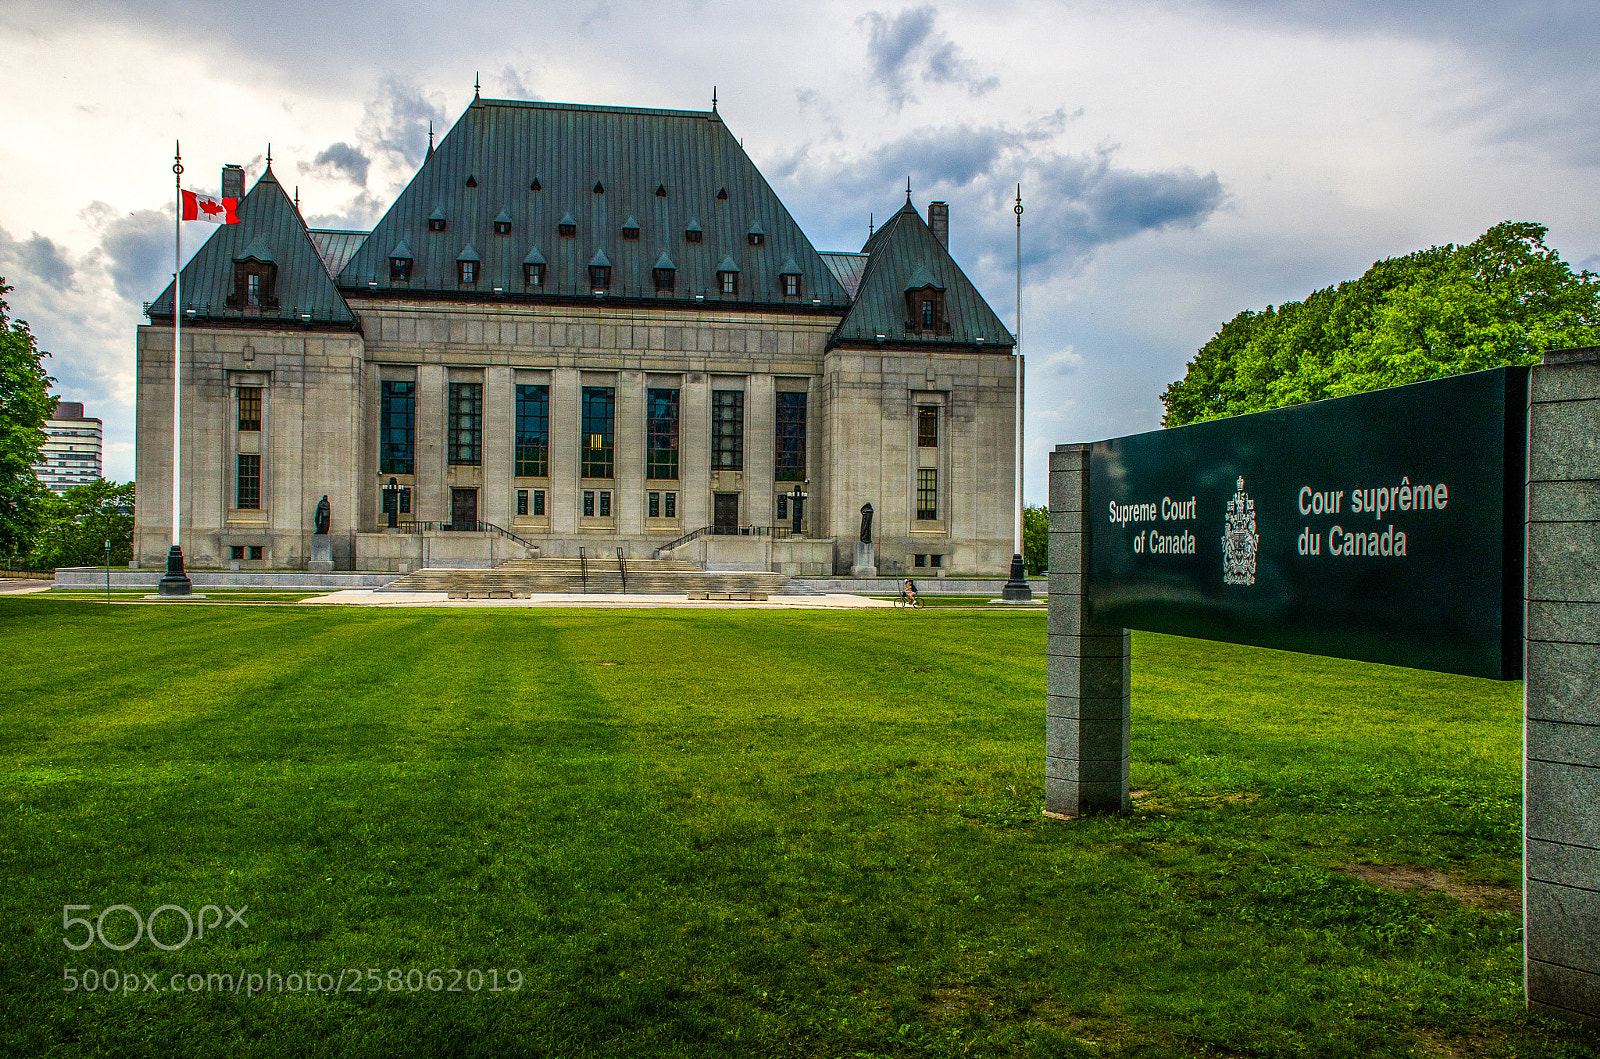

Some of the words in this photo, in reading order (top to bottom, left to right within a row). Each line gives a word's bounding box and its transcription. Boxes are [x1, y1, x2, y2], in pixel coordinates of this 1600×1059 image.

[1109, 500, 1157, 528] Supreme
[1161, 496, 1197, 521] Court
[1298, 485, 1344, 516] Cour
[1351, 476, 1449, 520] suprême
[1133, 530, 1146, 554] of
[1149, 529, 1196, 555] Canada
[1298, 526, 1321, 556] du
[1328, 524, 1407, 557] Canada
